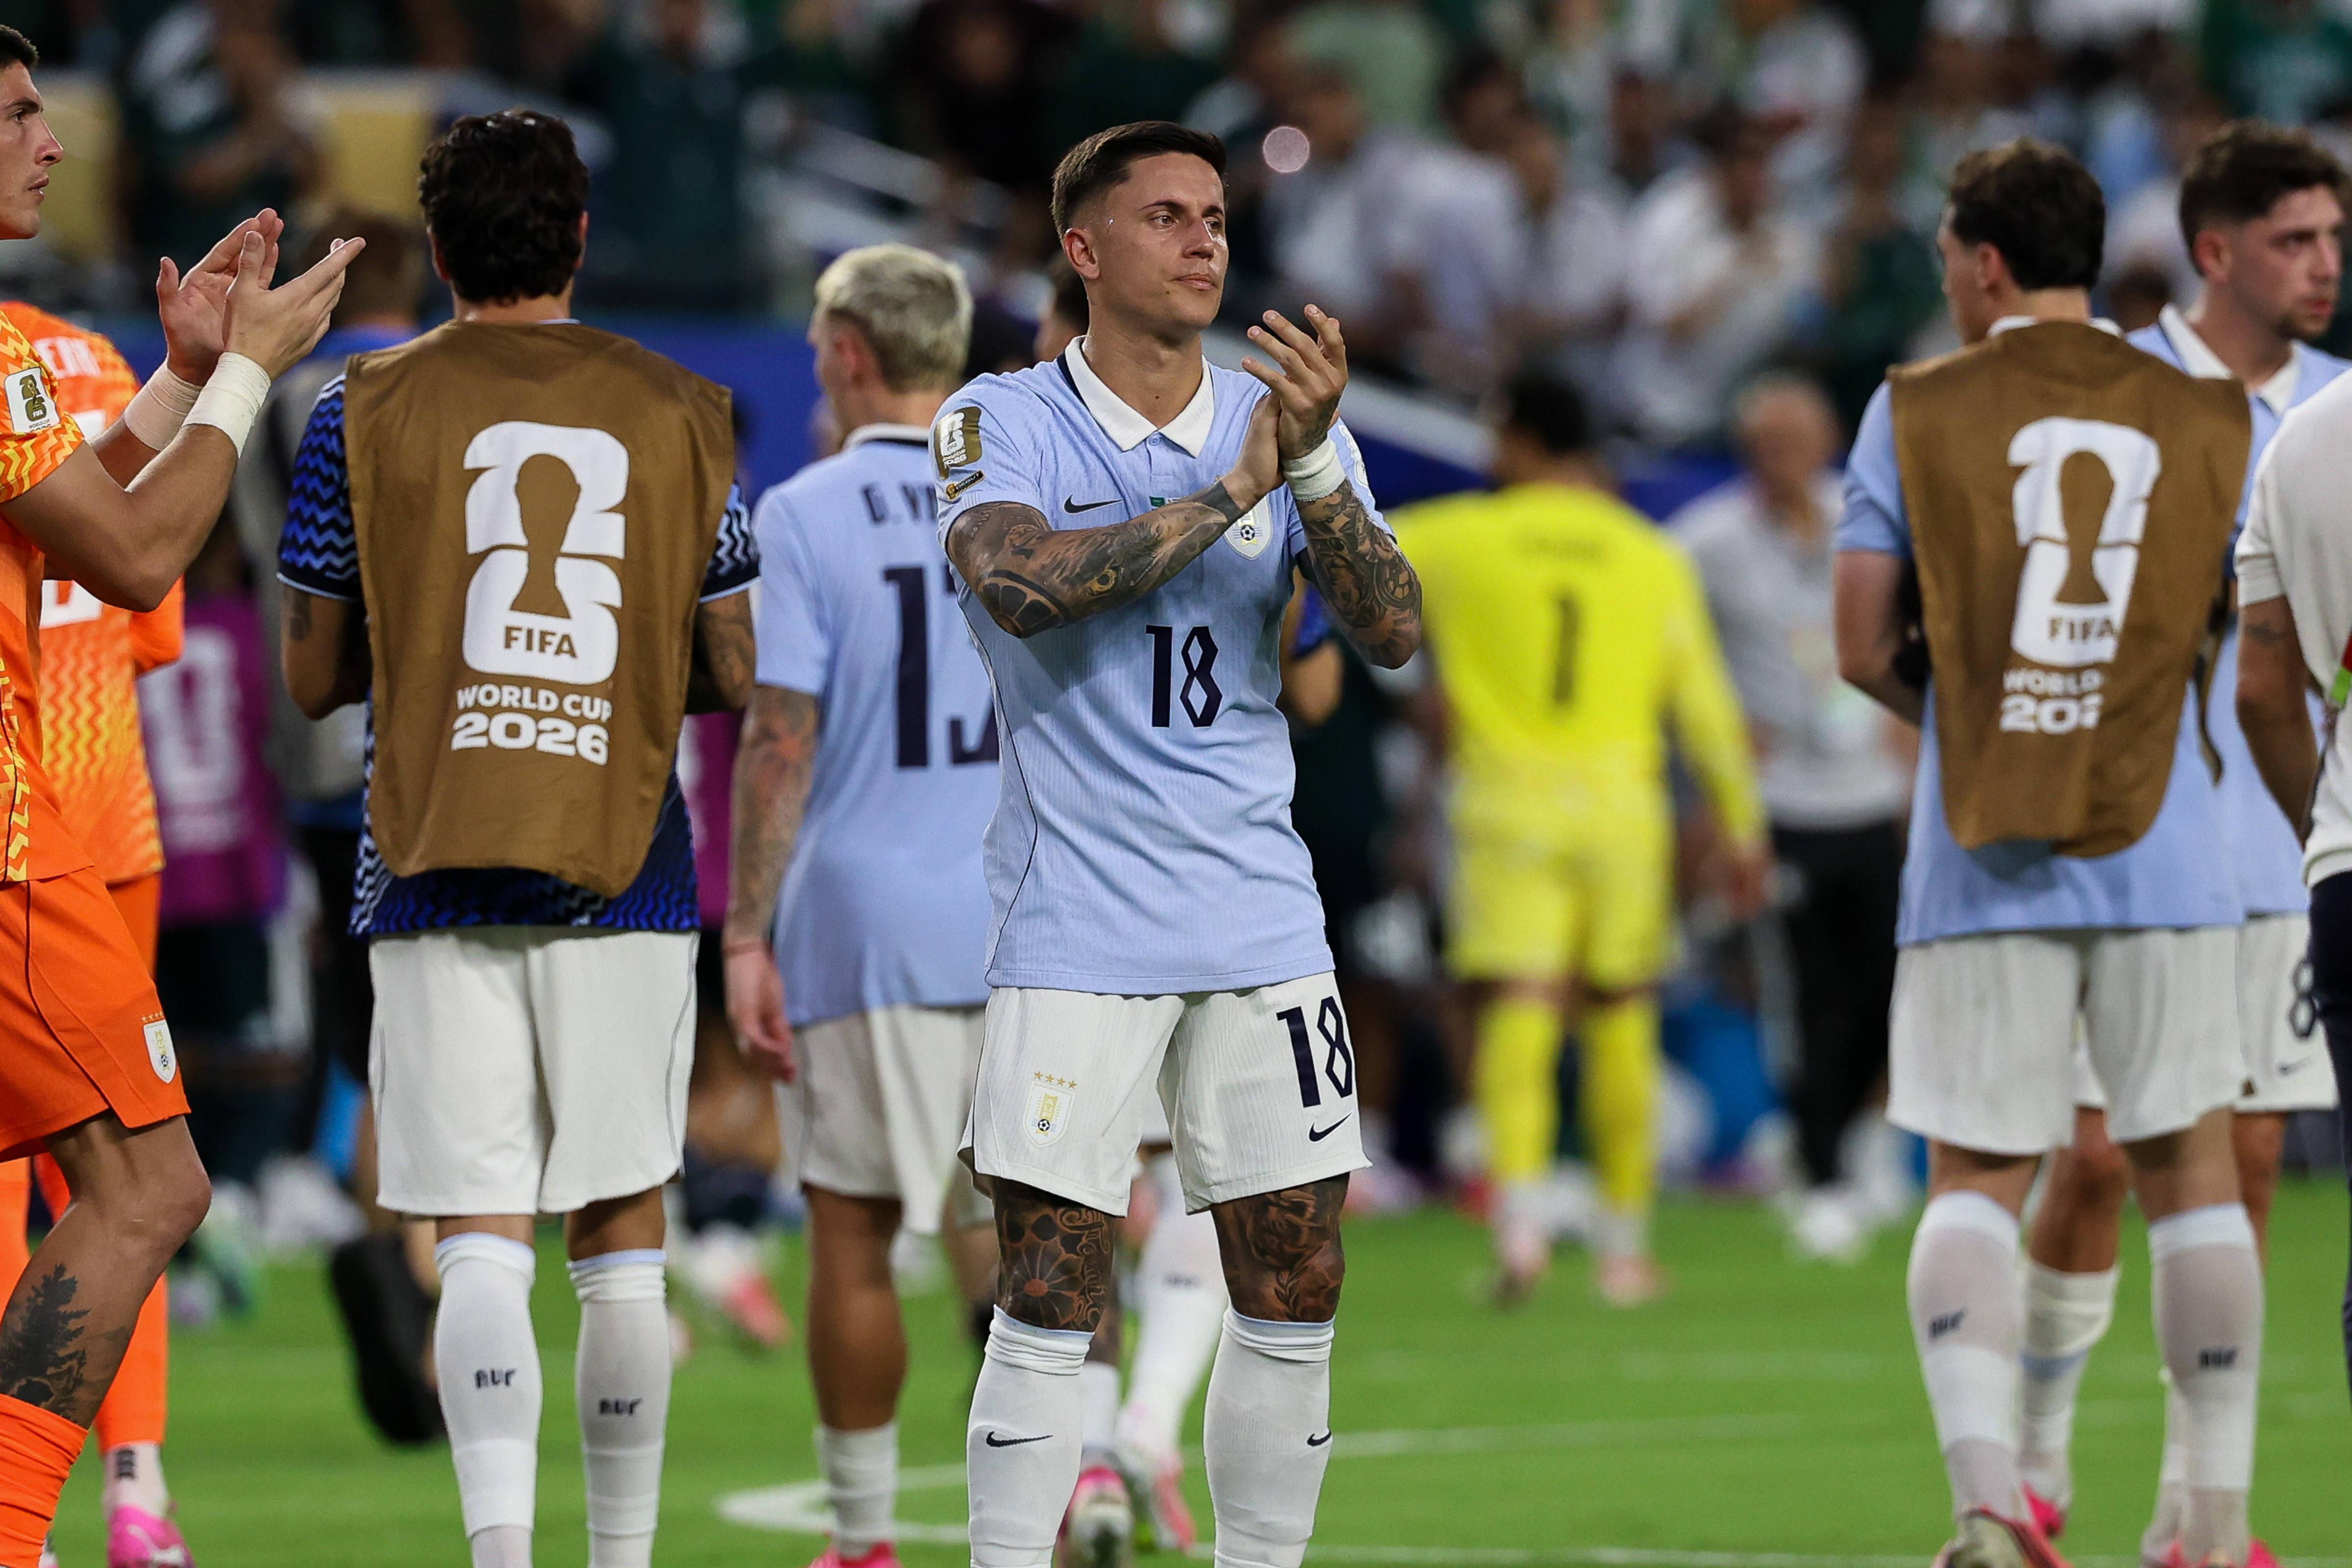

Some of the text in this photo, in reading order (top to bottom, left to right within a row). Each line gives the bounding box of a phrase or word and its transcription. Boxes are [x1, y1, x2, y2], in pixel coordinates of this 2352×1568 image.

[505, 625, 577, 659] FIFA
[2049, 618, 2115, 641] FIFA
[1145, 624, 1223, 728] 18
[456, 683, 612, 723] WORLD CUP
[451, 711, 609, 766] 2026
[1275, 995, 1353, 1108] 18
